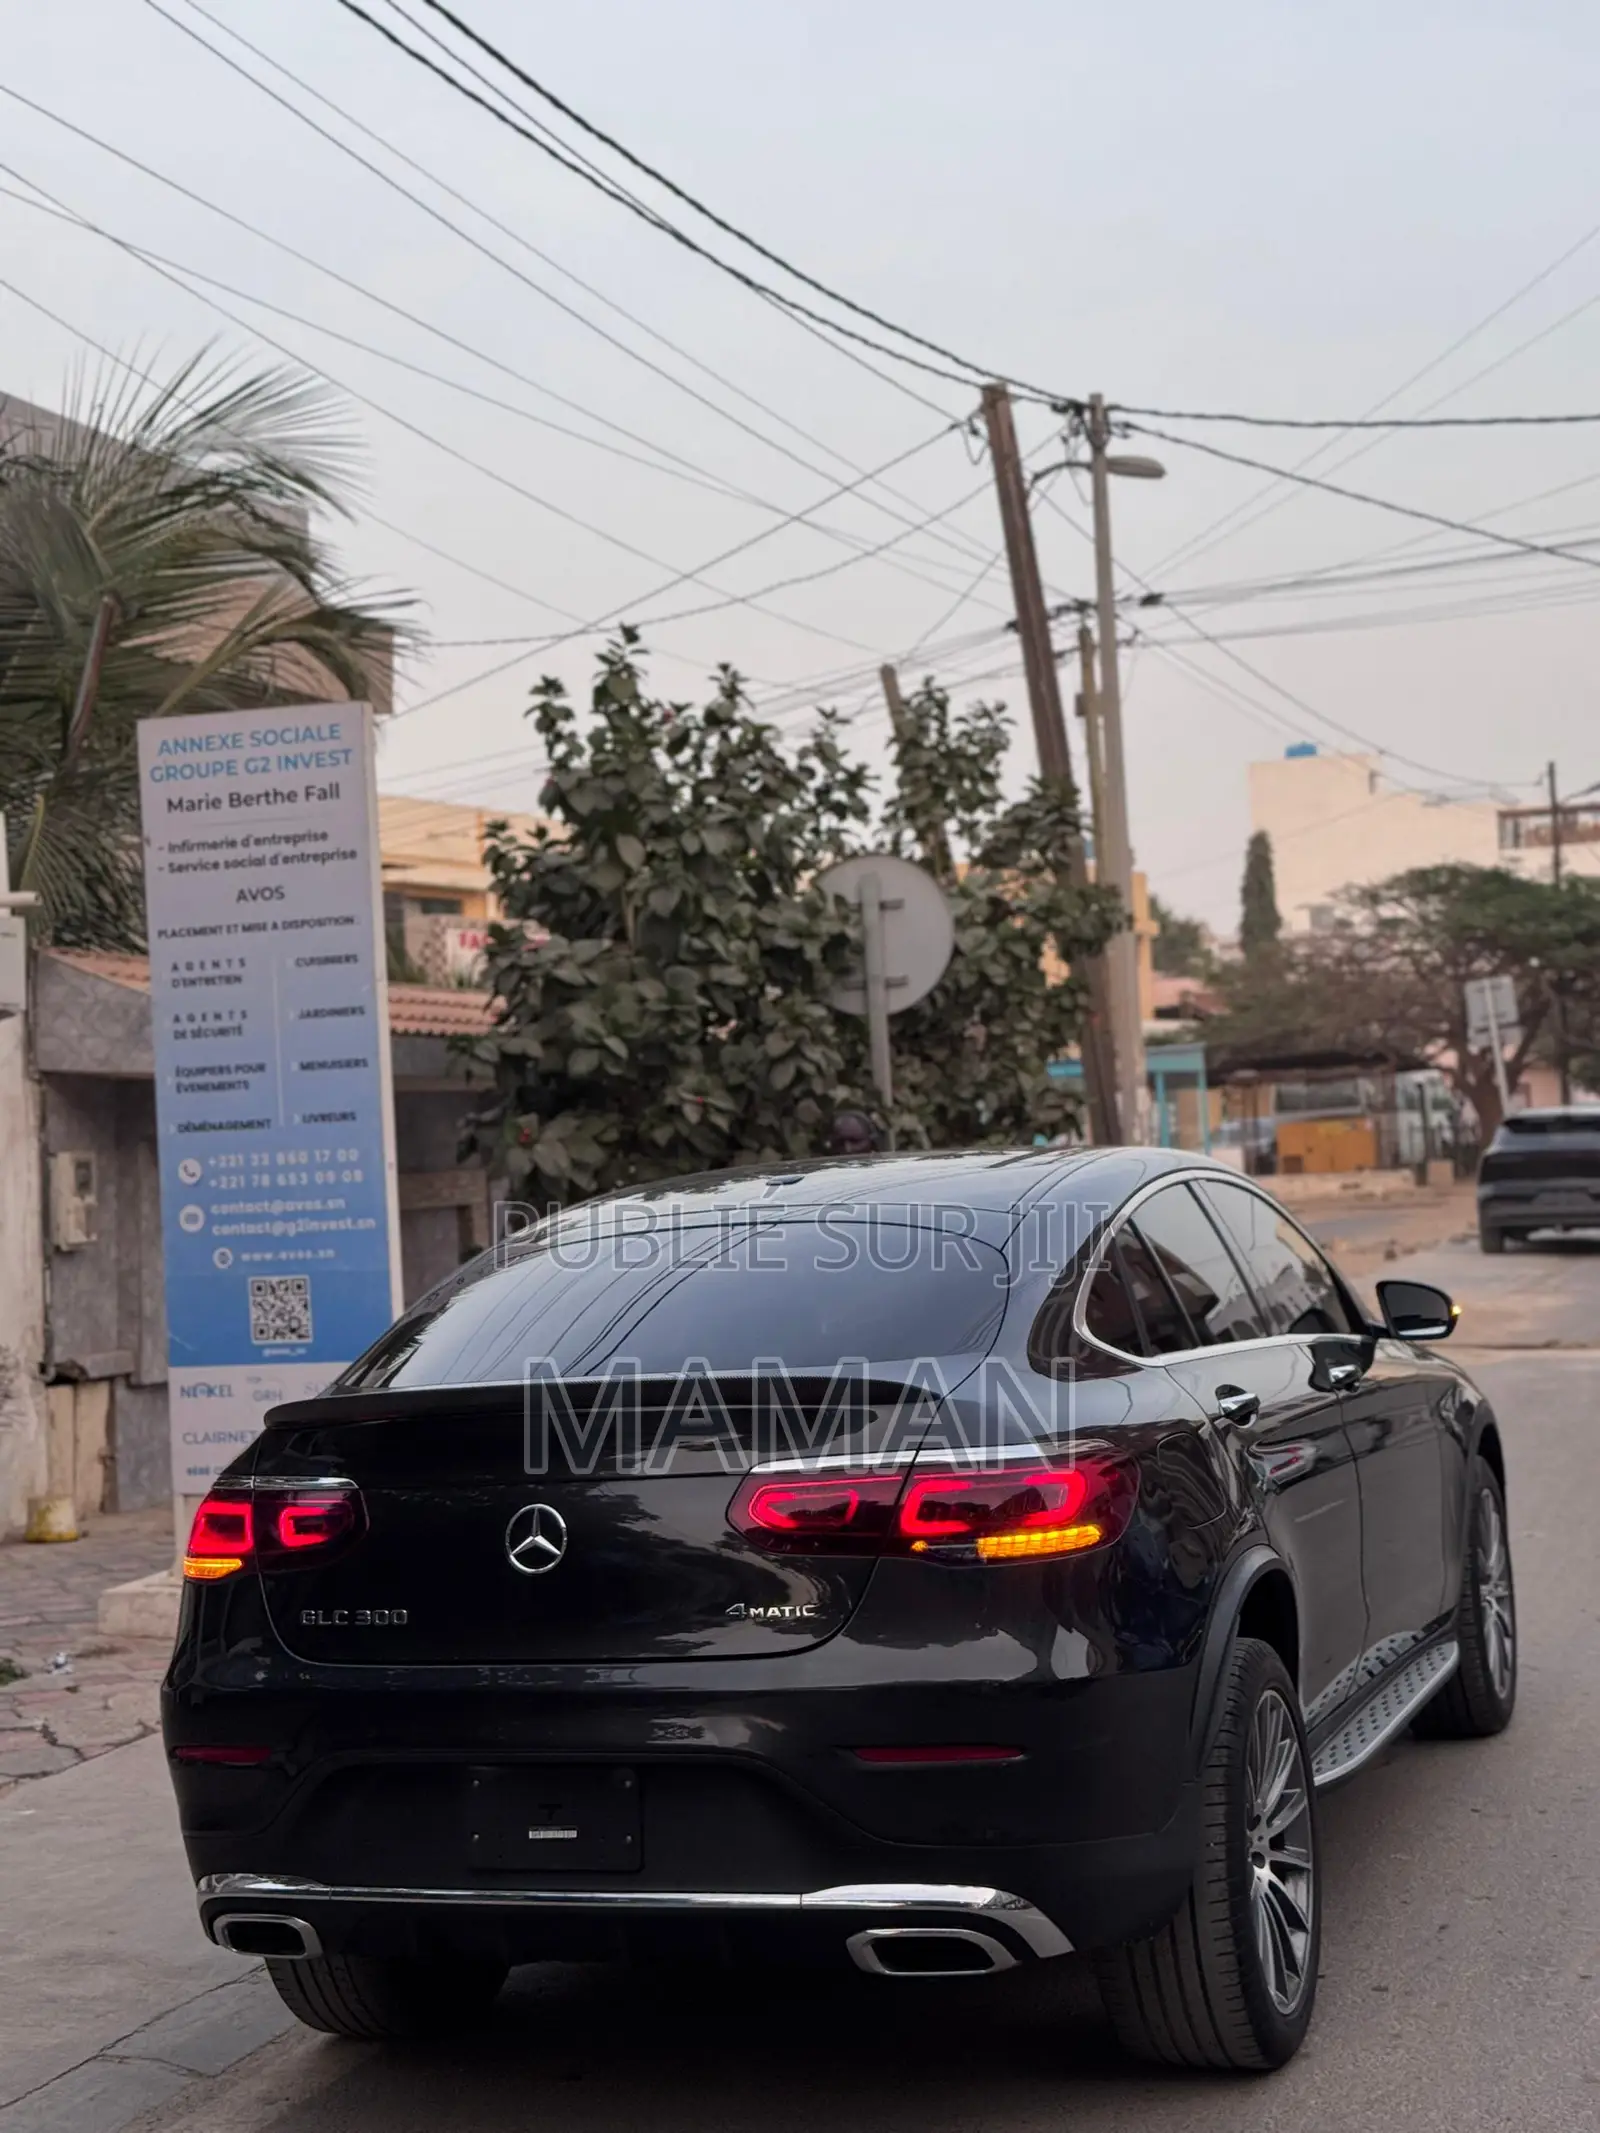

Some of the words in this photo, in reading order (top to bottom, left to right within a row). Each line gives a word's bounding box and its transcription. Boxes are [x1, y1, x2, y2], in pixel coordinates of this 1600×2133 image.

[157, 731, 244, 757] ANNEXE
[249, 723, 341, 748] SOCIALE
[149, 758, 239, 784] GROUPE
[244, 757, 272, 775] G2
[277, 748, 353, 772] INVEST
[166, 792, 222, 813] Marie
[228, 787, 298, 809] Berthe
[304, 783, 340, 802] Fall
[167, 834, 238, 855] Infirmerie
[241, 829, 329, 850] d'entreprise
[167, 859, 220, 874] Service
[223, 854, 266, 870] social
[269, 848, 358, 869] d'entreprise
[235, 885, 286, 904] AVOS
[157, 925, 223, 939] PLACEMENT
[226, 923, 239, 934] ET
[241, 921, 267, 934] MISE
[281, 915, 355, 931] DISPOSITION
[298, 1005, 366, 1021] JARDINIERS
[174, 1029, 187, 1040] DE
[190, 1024, 243, 1040] SÉCURITÉ
[313, 1148, 331, 1163] 17
[300, 1609, 350, 1627] GLC
[355, 1608, 410, 1627] 300
[724, 1601, 818, 1620] 4MATIC
